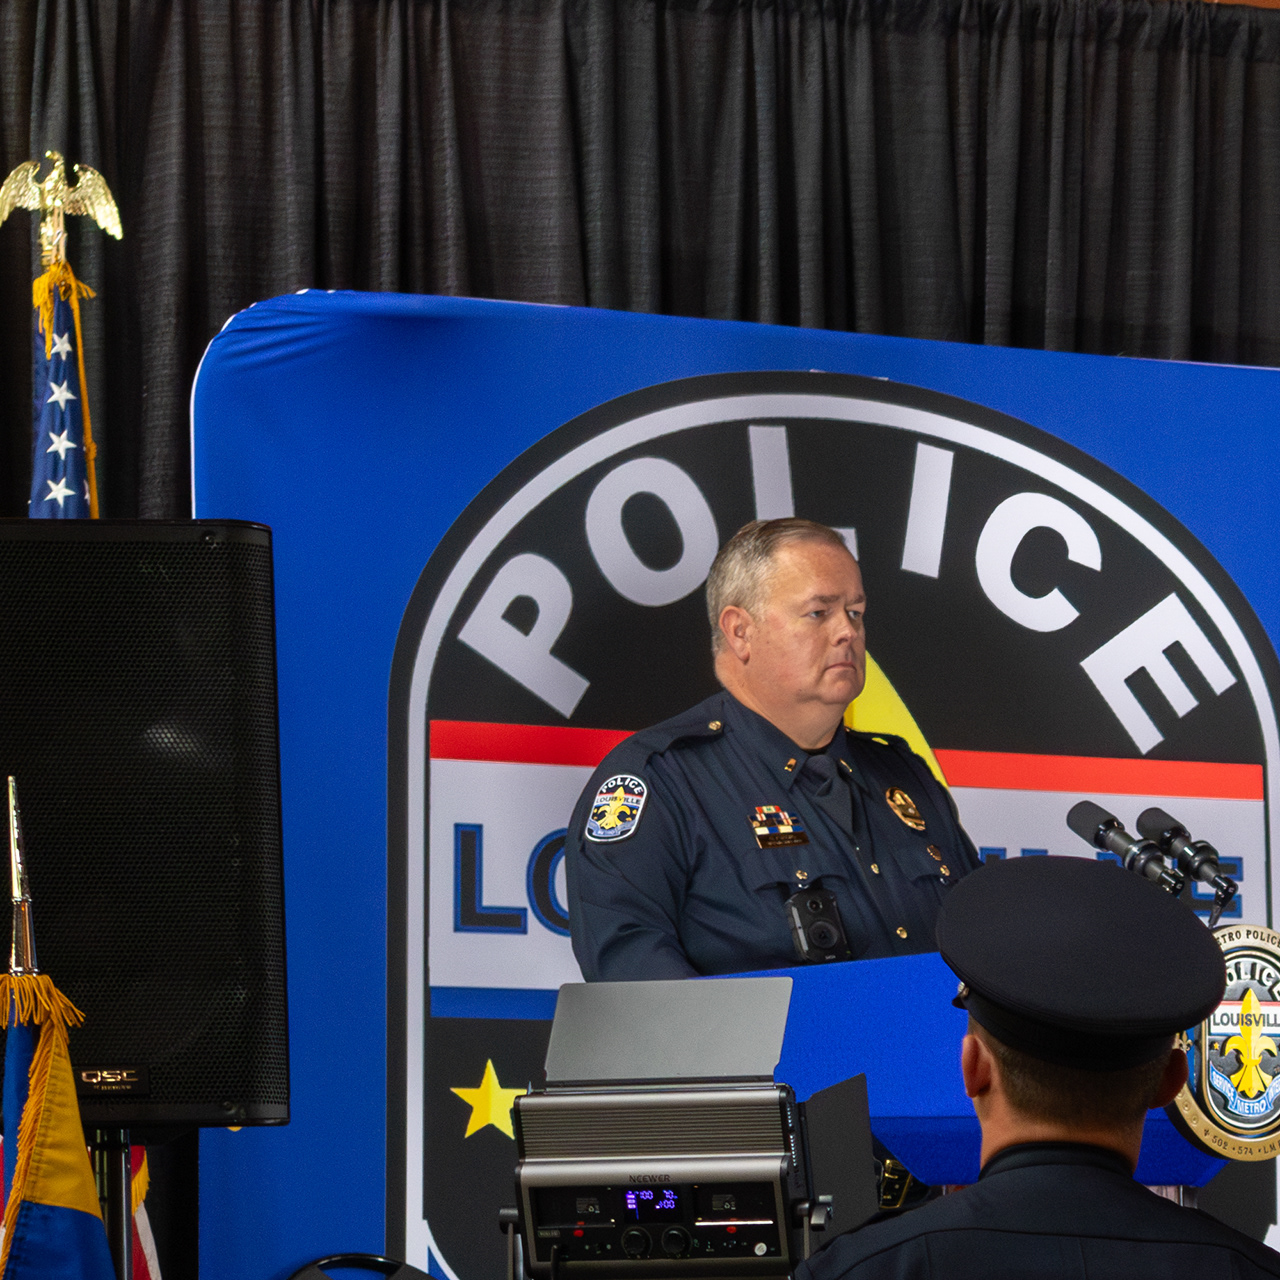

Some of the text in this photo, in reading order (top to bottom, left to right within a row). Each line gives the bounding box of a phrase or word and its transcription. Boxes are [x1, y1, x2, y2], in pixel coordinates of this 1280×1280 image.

[457, 424, 1238, 756] POLICE
[600, 777, 644, 795] POLICE
[81, 1070, 139, 1084] QSC
[1237, 1099, 1267, 1114] METRO
[1211, 1136, 1229, 1150] 502
[1237, 1146, 1254, 1156] 574
